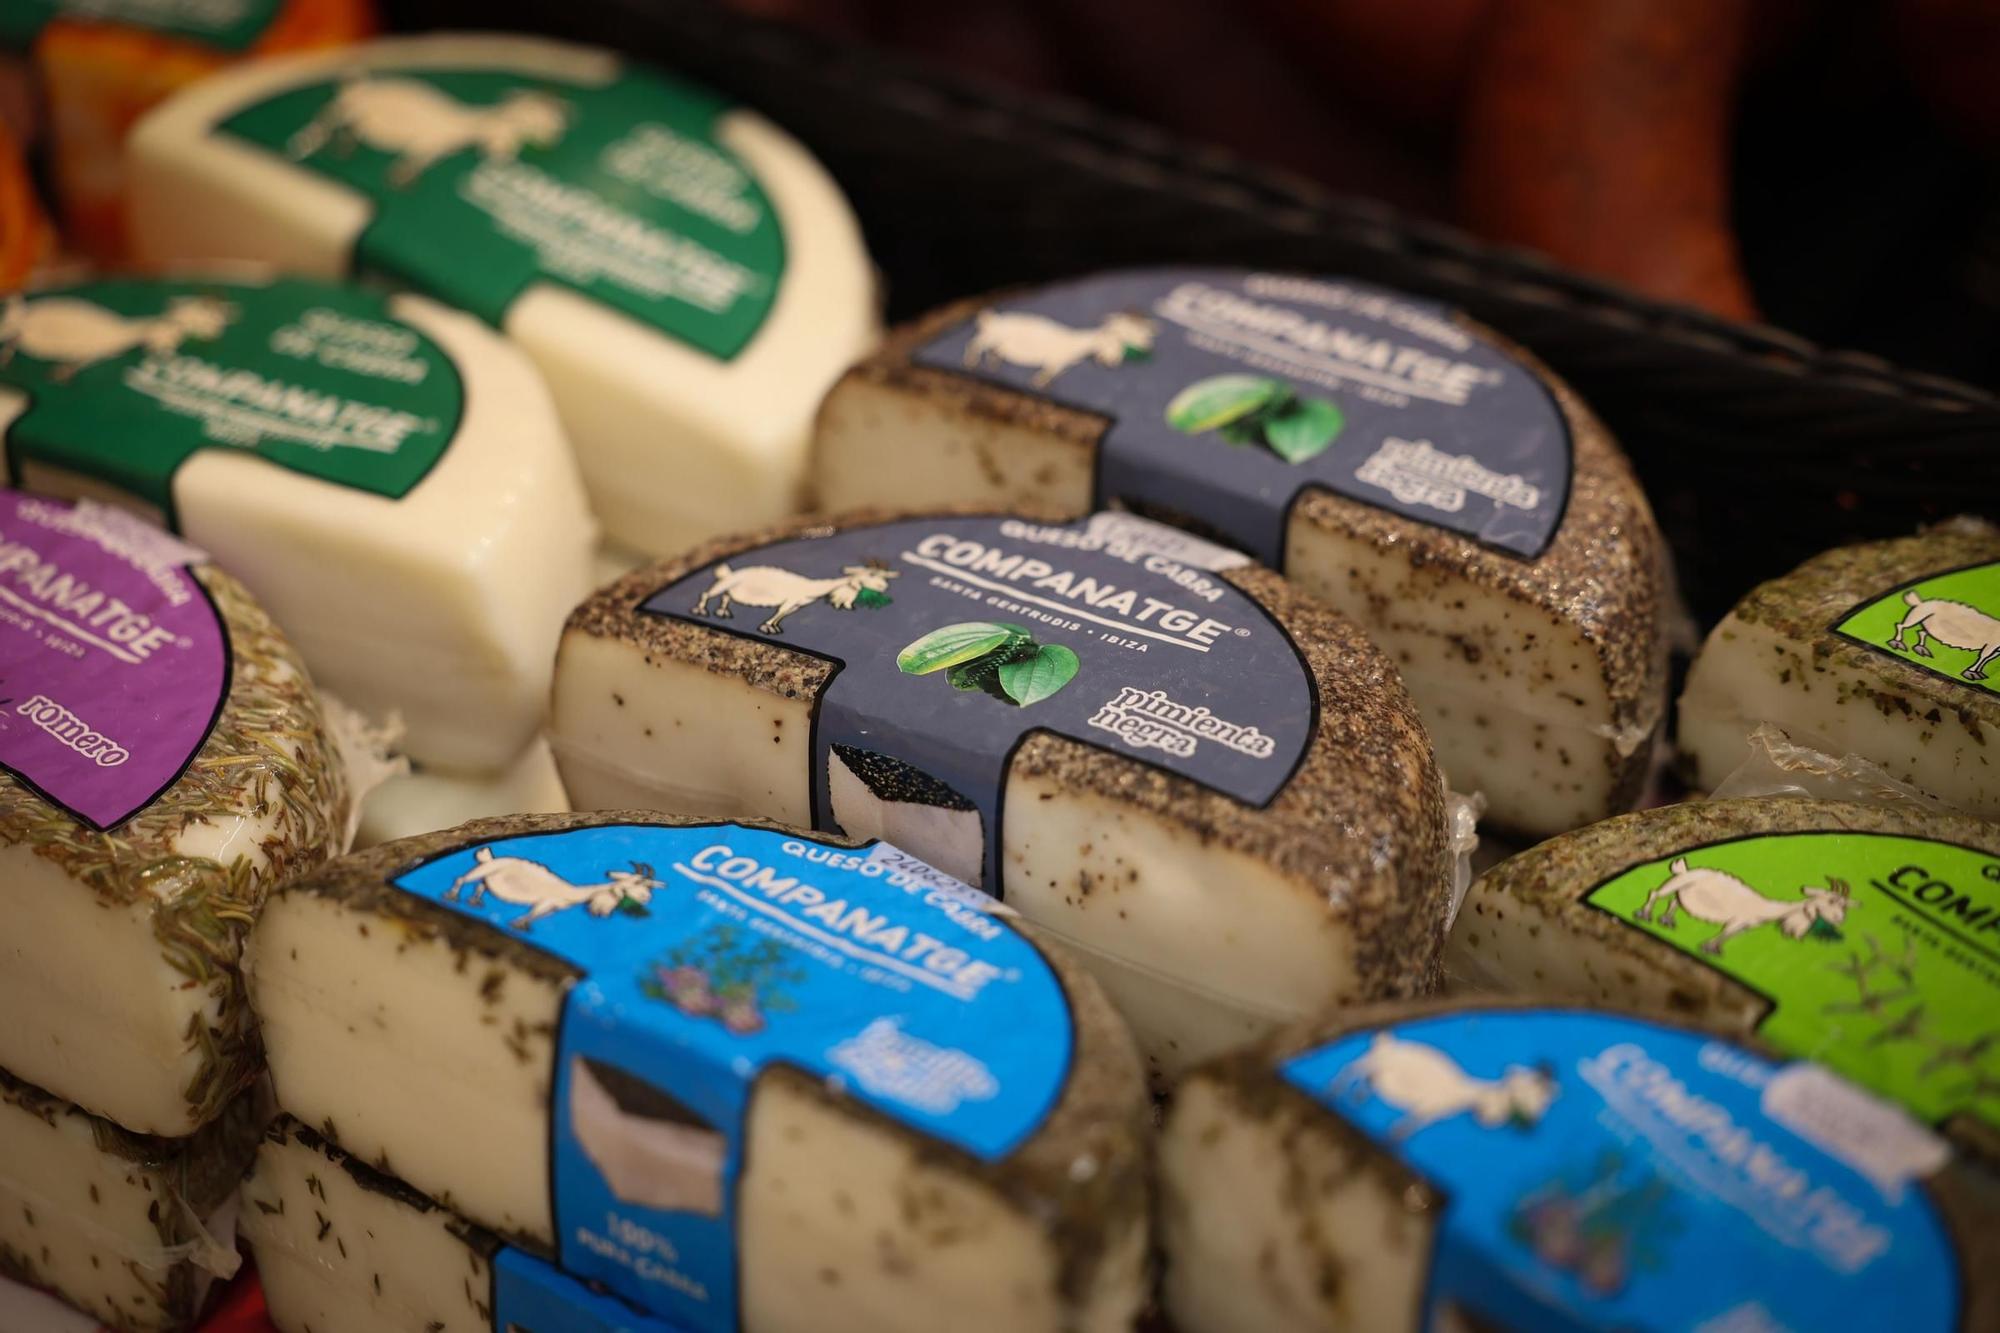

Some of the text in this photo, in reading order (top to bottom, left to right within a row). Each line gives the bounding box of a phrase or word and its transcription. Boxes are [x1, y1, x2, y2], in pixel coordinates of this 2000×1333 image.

[917, 534, 1232, 646] COMPANATGE
[1001, 520, 1102, 550] QUESO
[1144, 556, 1224, 602] CABRA
[929, 576, 1149, 653] SANTA GERTRUDIS IBIZA
[16, 695, 129, 766] romero
[1088, 707, 1197, 758] negra
[1107, 686, 1275, 758] pimienta
[782, 841, 884, 877] QUESO
[886, 872, 923, 895] DE
[691, 845, 999, 990] COMPANATGE
